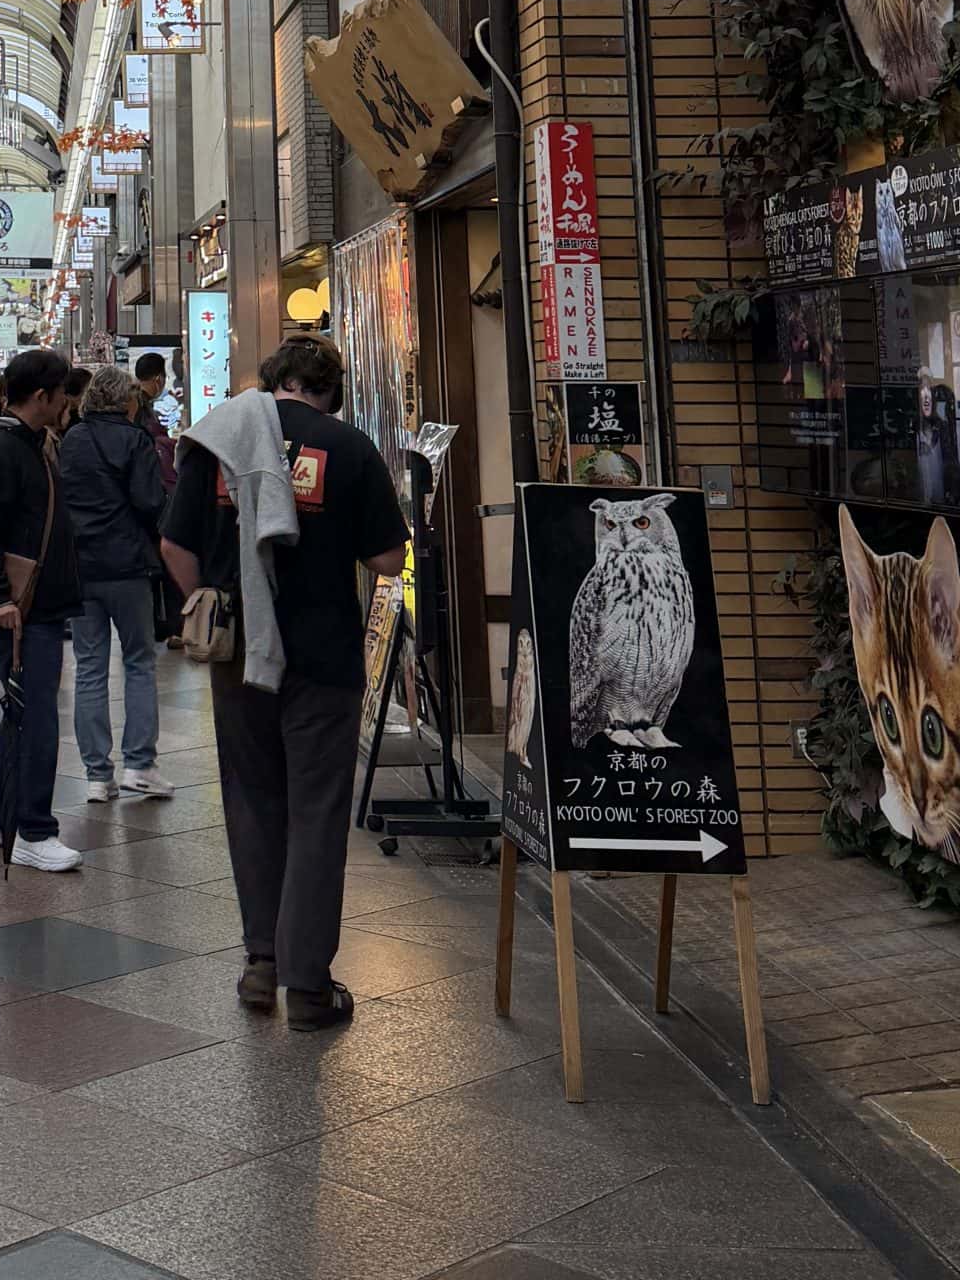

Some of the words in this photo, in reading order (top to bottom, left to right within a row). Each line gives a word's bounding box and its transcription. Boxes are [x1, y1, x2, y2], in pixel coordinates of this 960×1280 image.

[560, 124, 588, 211] らーめん
[564, 267, 578, 356] RAMEN
[583, 267, 597, 357] SENNOKAZE
[201, 311, 216, 360] キリン
[587, 401, 624, 432] 塩
[607, 750, 668, 773] 京都の
[562, 775, 722, 804] フクロウの森
[556, 805, 602, 821] KYOTO
[656, 808, 705, 824] FOREST
[709, 809, 739, 825] ZOO
